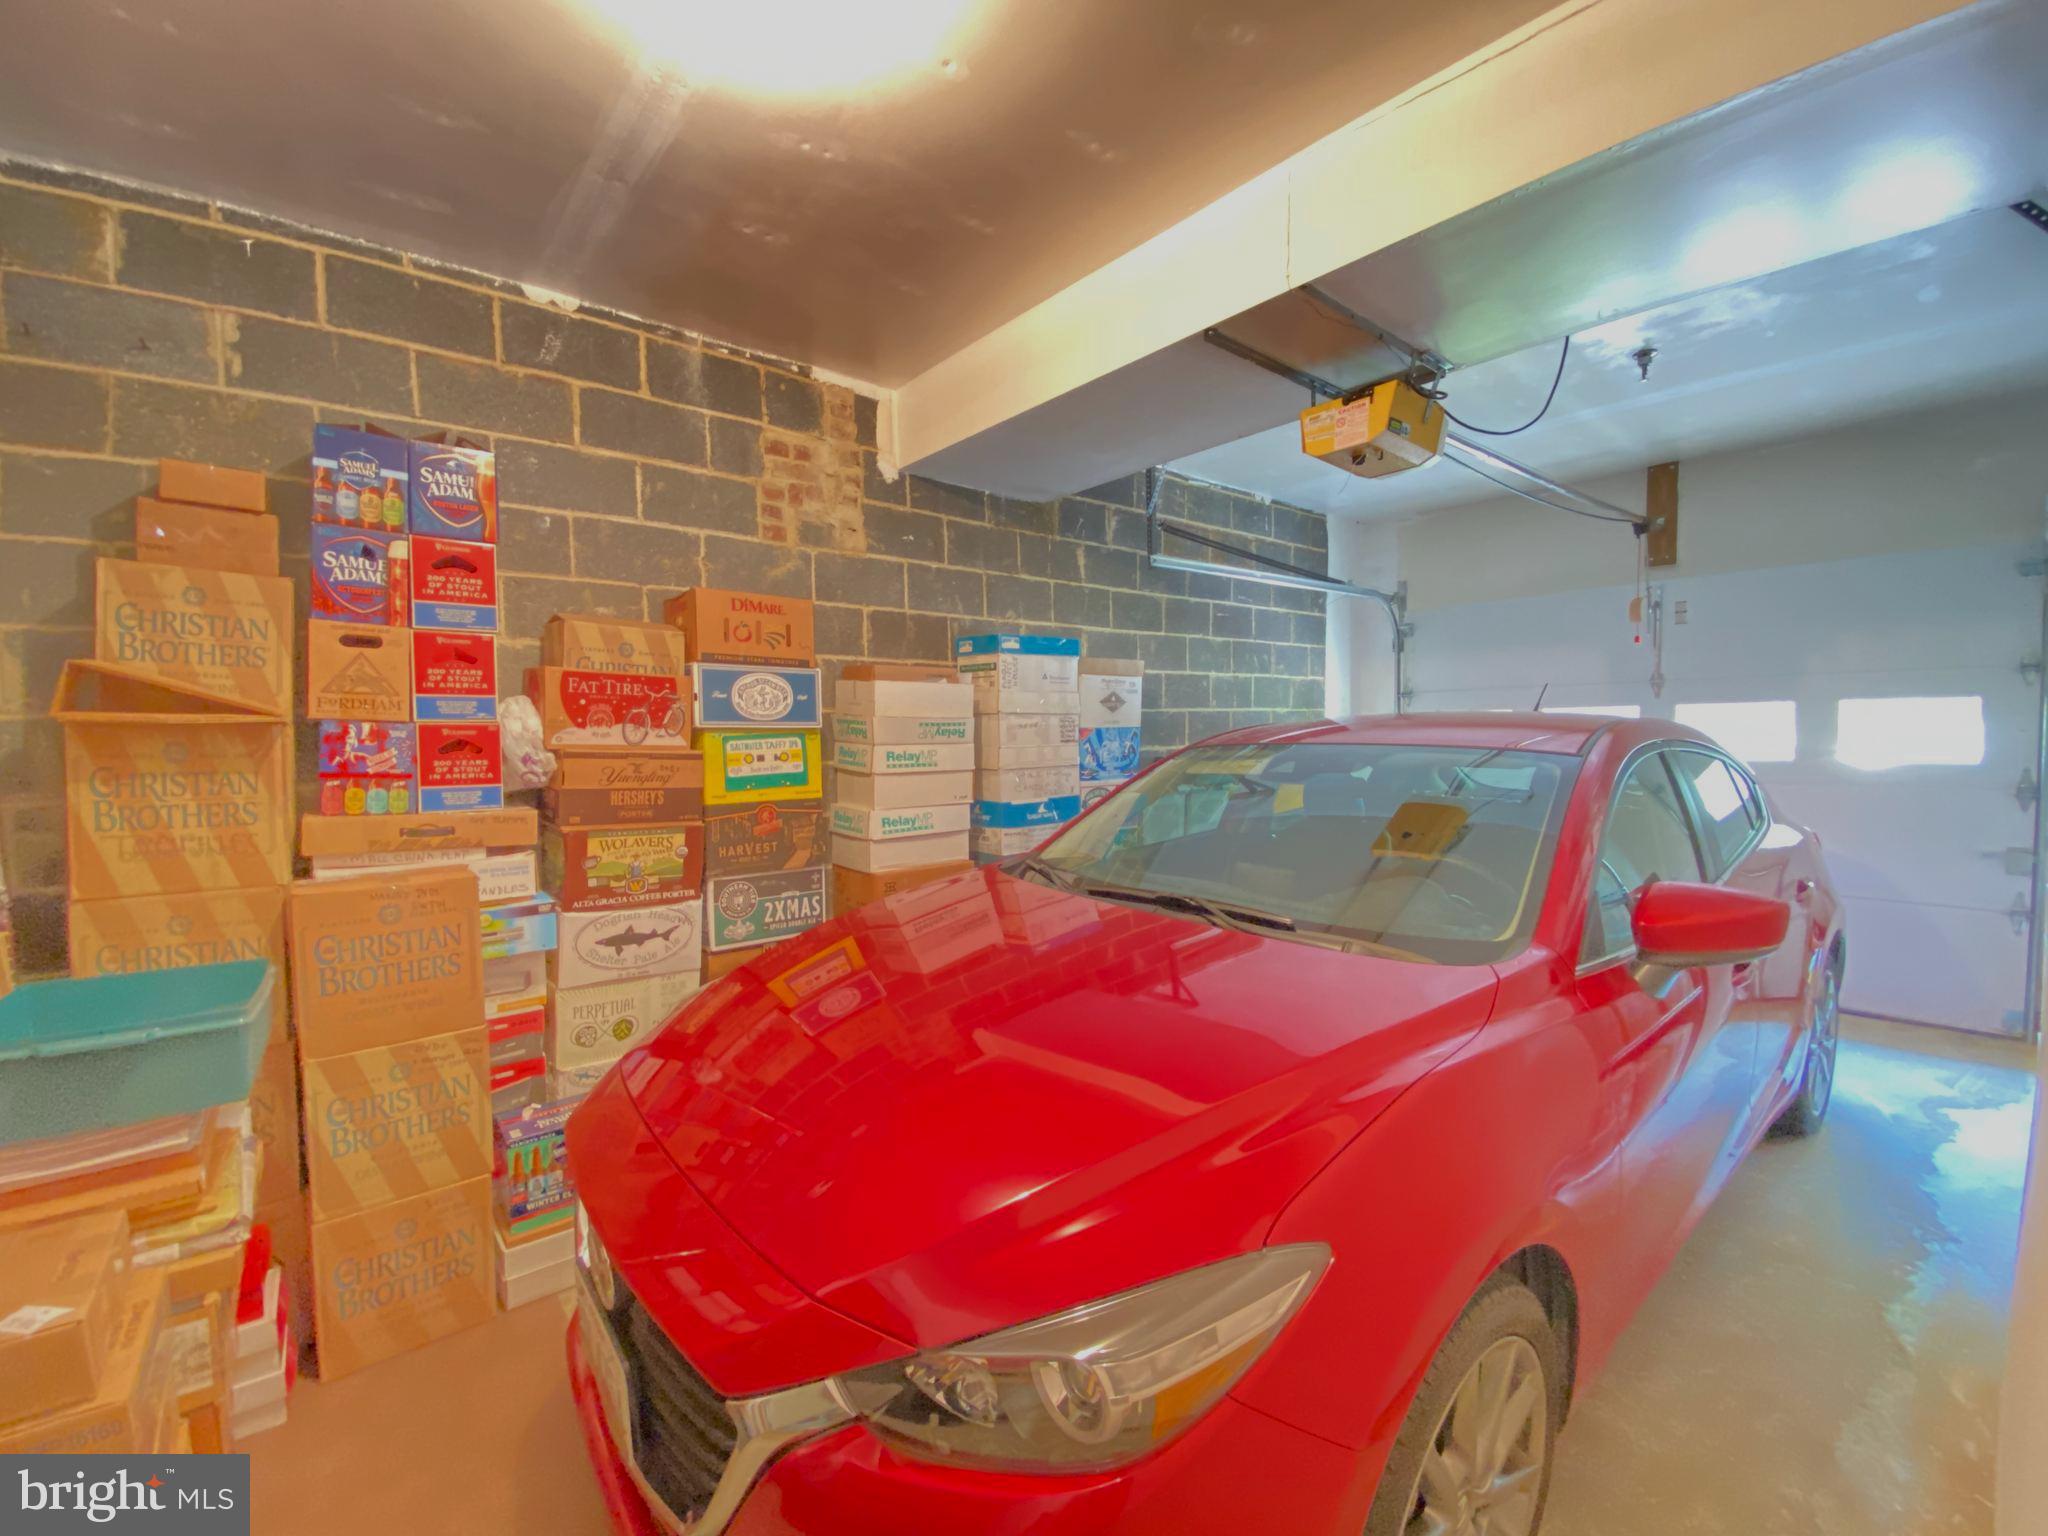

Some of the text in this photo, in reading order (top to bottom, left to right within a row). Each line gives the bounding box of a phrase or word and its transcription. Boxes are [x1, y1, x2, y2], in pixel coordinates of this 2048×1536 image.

[426, 574, 484, 586] 200 YEARS
[438, 590, 488, 599] AMERICA
[446, 583, 482, 591] STOUT
[115, 602, 269, 641] CHRISTIAN
[118, 631, 268, 669] BROTHERS
[568, 677, 644, 696] FAT TIRE
[89, 766, 258, 801] CHRISTIAN
[599, 767, 673, 786] Yuengling
[93, 801, 258, 833] BROTHERS
[719, 842, 778, 858] HARVEST
[572, 900, 594, 909] ALTA
[595, 896, 627, 906] GRACIA
[663, 889, 695, 899] PORTER
[764, 895, 821, 923] 2XMAS
[314, 922, 462, 966] CHRISTIAN
[633, 951, 658, 965] Pale
[319, 952, 463, 998] BROTHERS
[573, 997, 637, 1019] PERPETUAL
[326, 1073, 471, 1127] CHRISTIAN
[330, 1102, 471, 1159] BROTHERS
[334, 1222, 475, 1290] CHRISTIAN
[338, 1250, 475, 1320] BROTHERS
